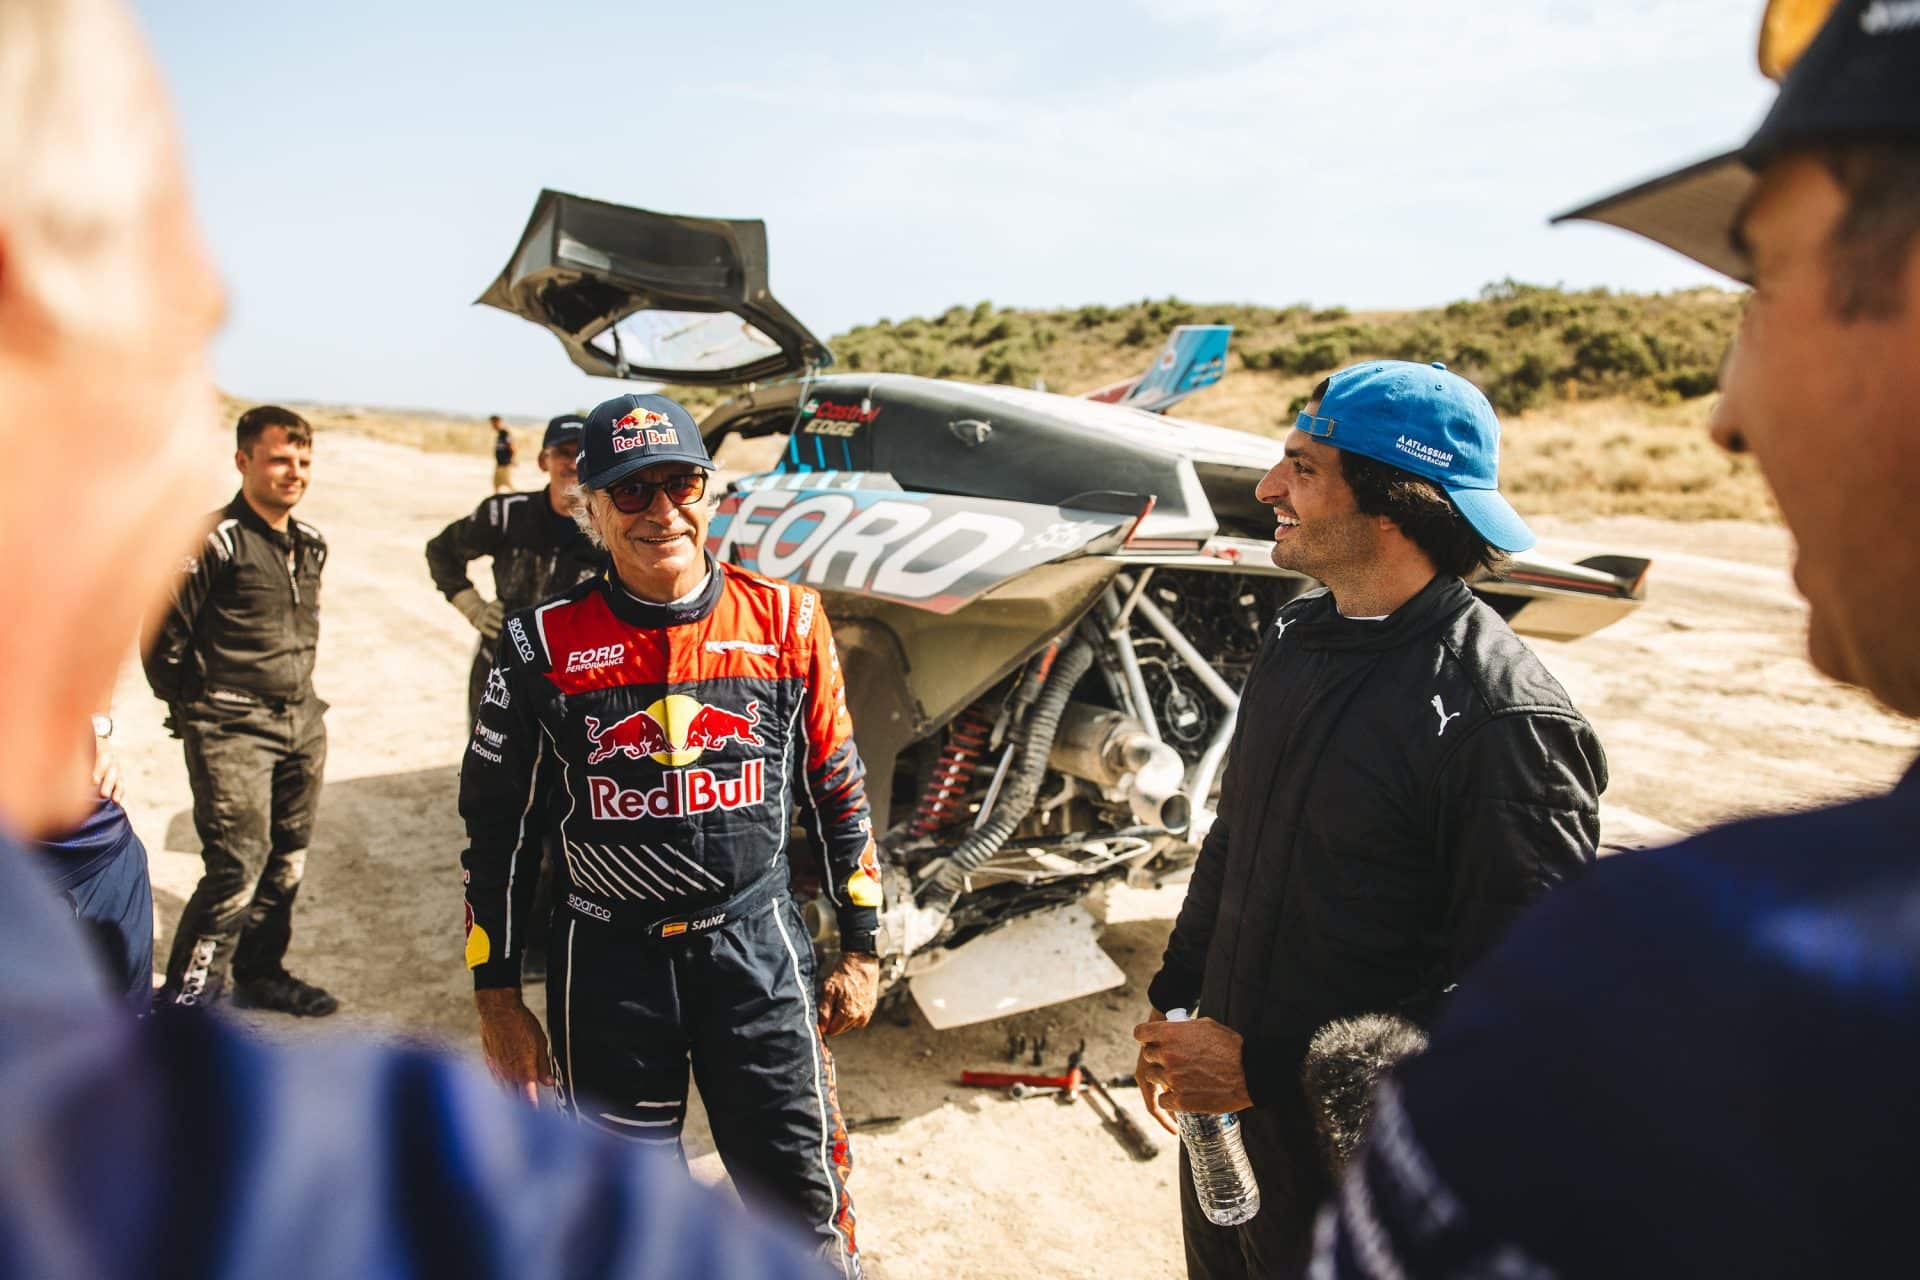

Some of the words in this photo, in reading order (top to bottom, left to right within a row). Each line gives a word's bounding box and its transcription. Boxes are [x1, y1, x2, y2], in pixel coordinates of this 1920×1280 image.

[804, 418, 861, 437] EDGE
[612, 430, 646, 454] Red
[645, 428, 679, 445] Bull
[1405, 437, 1454, 462] ATLASSIAN
[717, 488, 1024, 599] FORD
[509, 617, 535, 663] sparco
[565, 656, 625, 673] PERFORMANCE
[566, 644, 625, 667] FORD
[477, 742, 502, 763] Castrol
[587, 770, 683, 820] Red
[685, 757, 765, 815] Bull
[568, 893, 612, 920] sparco
[691, 913, 726, 931] SAINZ
